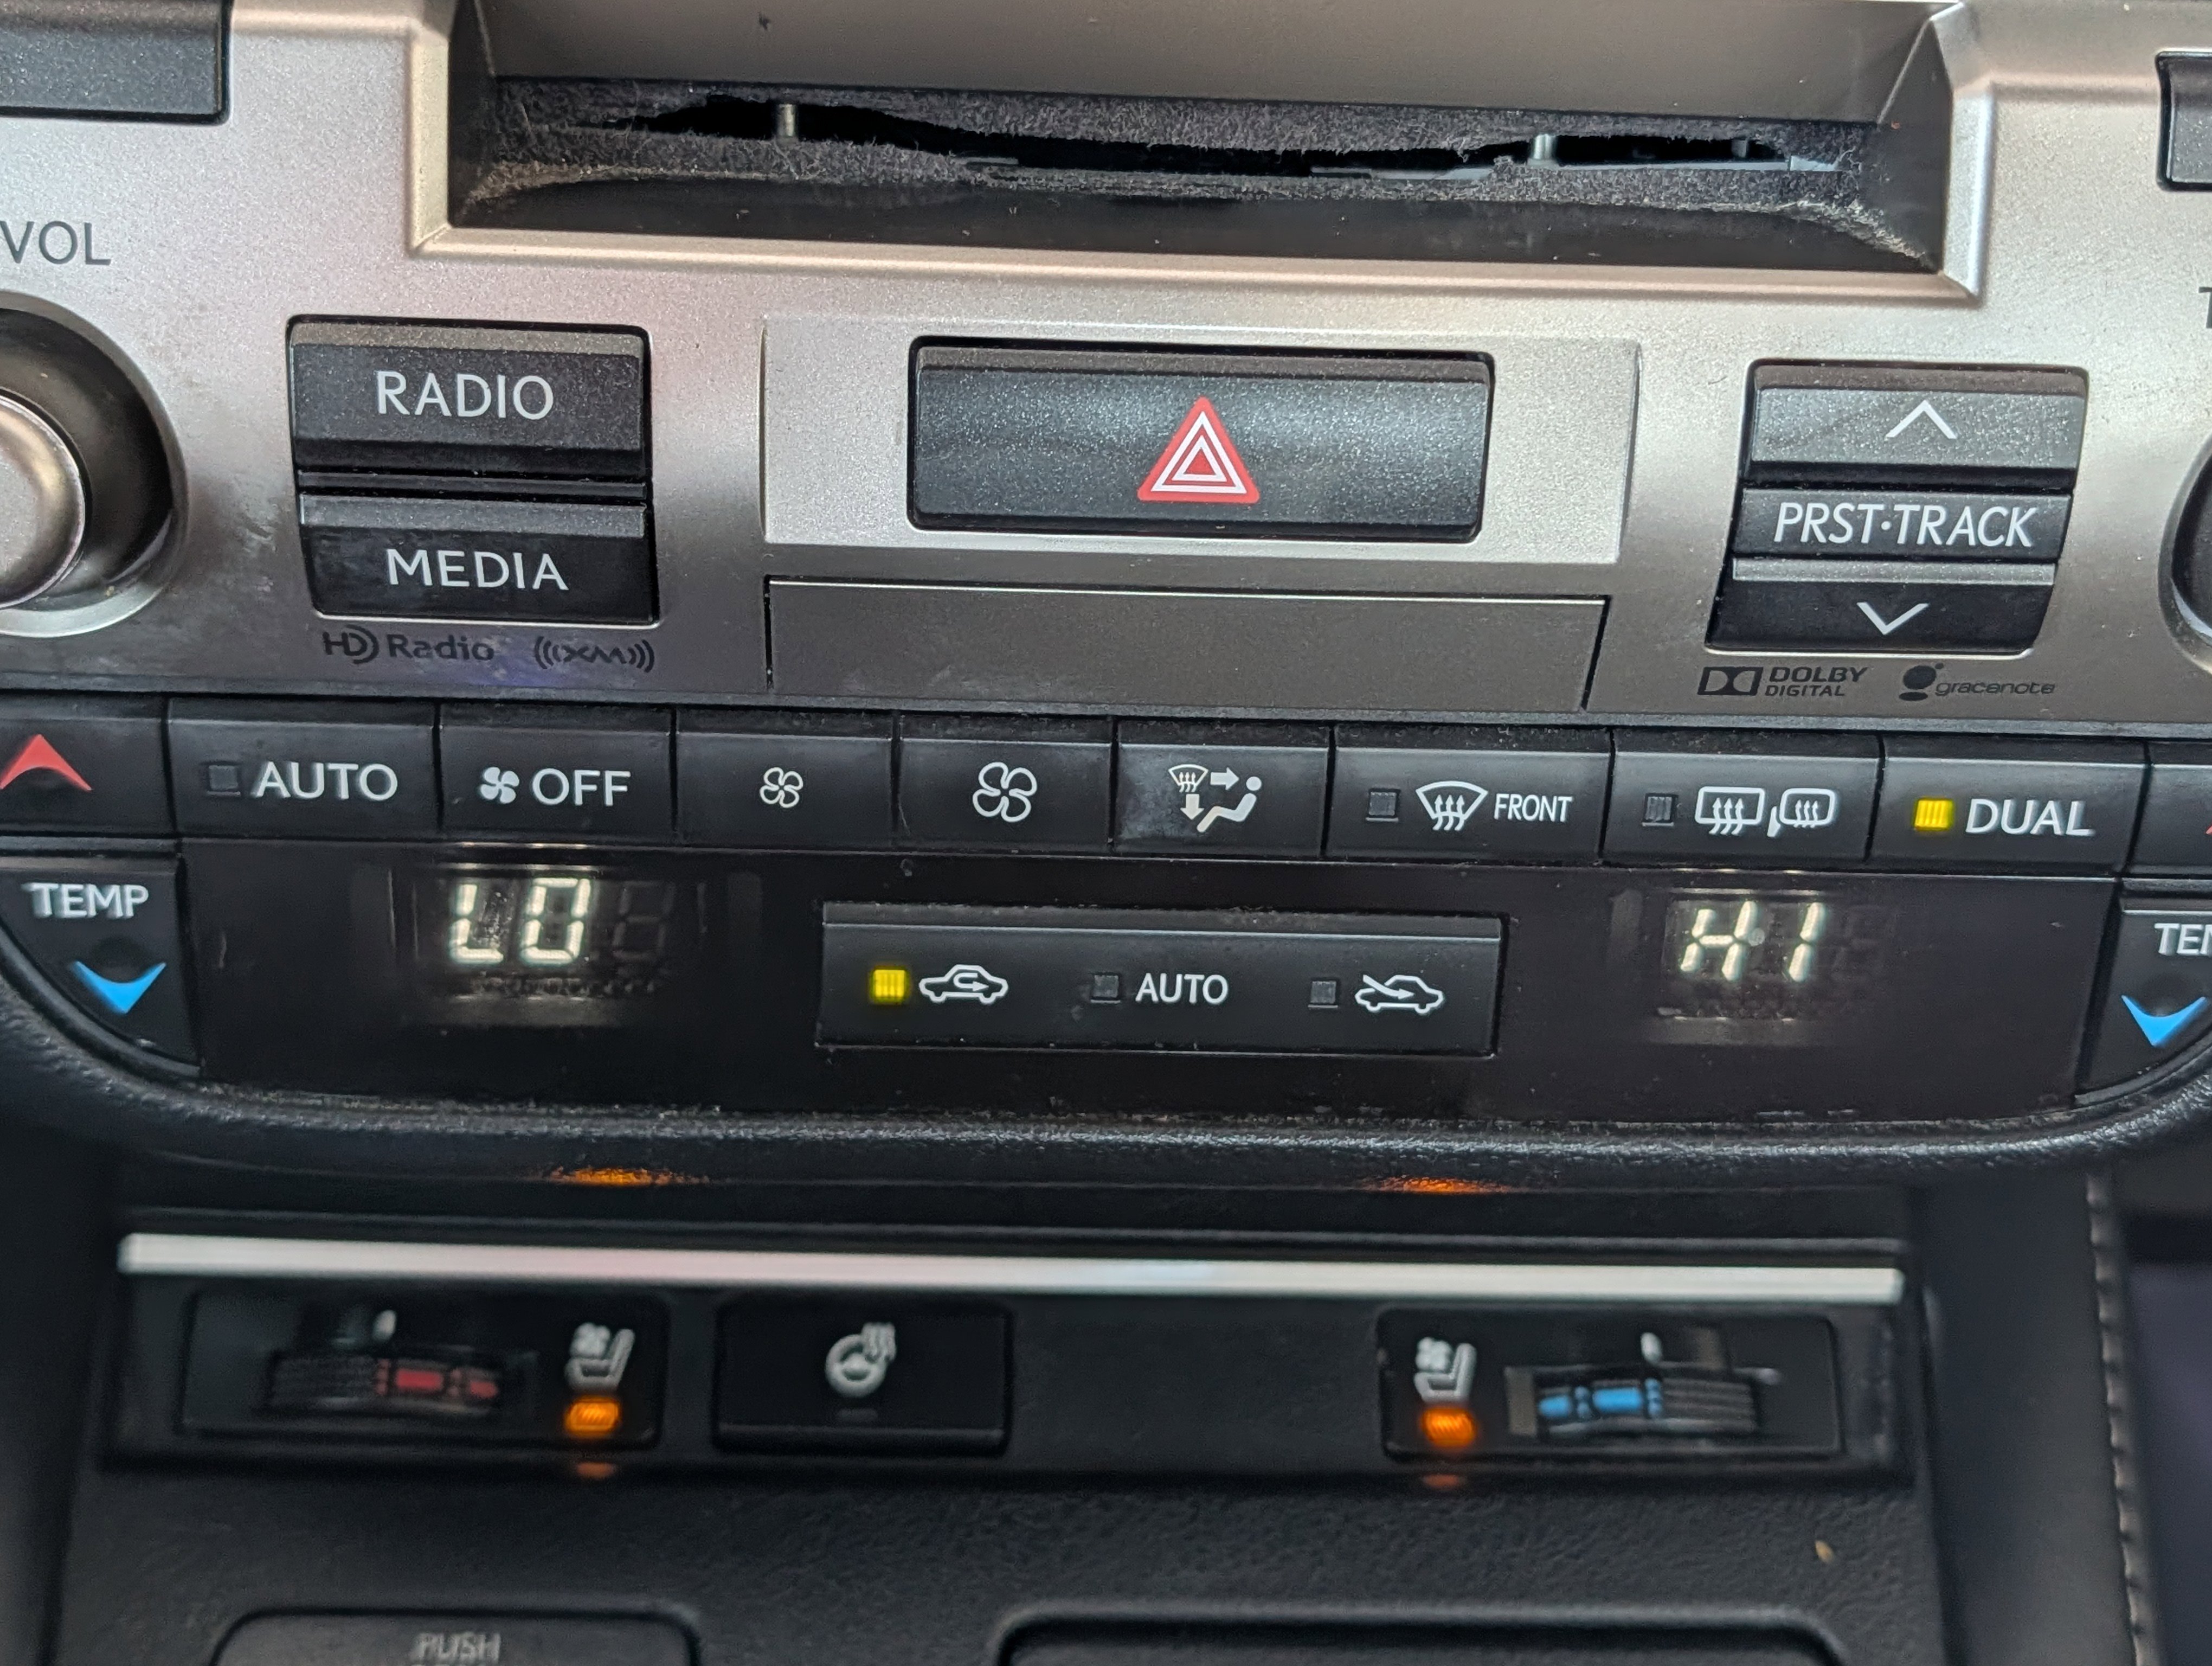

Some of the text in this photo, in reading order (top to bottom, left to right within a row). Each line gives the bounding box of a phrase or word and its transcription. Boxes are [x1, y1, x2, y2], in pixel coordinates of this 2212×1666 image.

[0, 221, 111, 265] VOL
[376, 370, 554, 419] RADIO
[387, 548, 569, 591] MEDIA
[387, 633, 494, 660] Radio
[1765, 685, 1845, 696] DIGITAL
[1769, 667, 1868, 682] DOLBY
[1935, 682, 2055, 696] gracenote
[252, 761, 398, 800] AUTO
[532, 768, 631, 806] OFF
[1494, 793, 1572, 822] FRONT
[1965, 798, 2094, 836] DUAL
[22, 882, 149, 918] TEMP
[1135, 973, 1229, 1004] AUTO
[409, 1632, 501, 1662] PUSH
